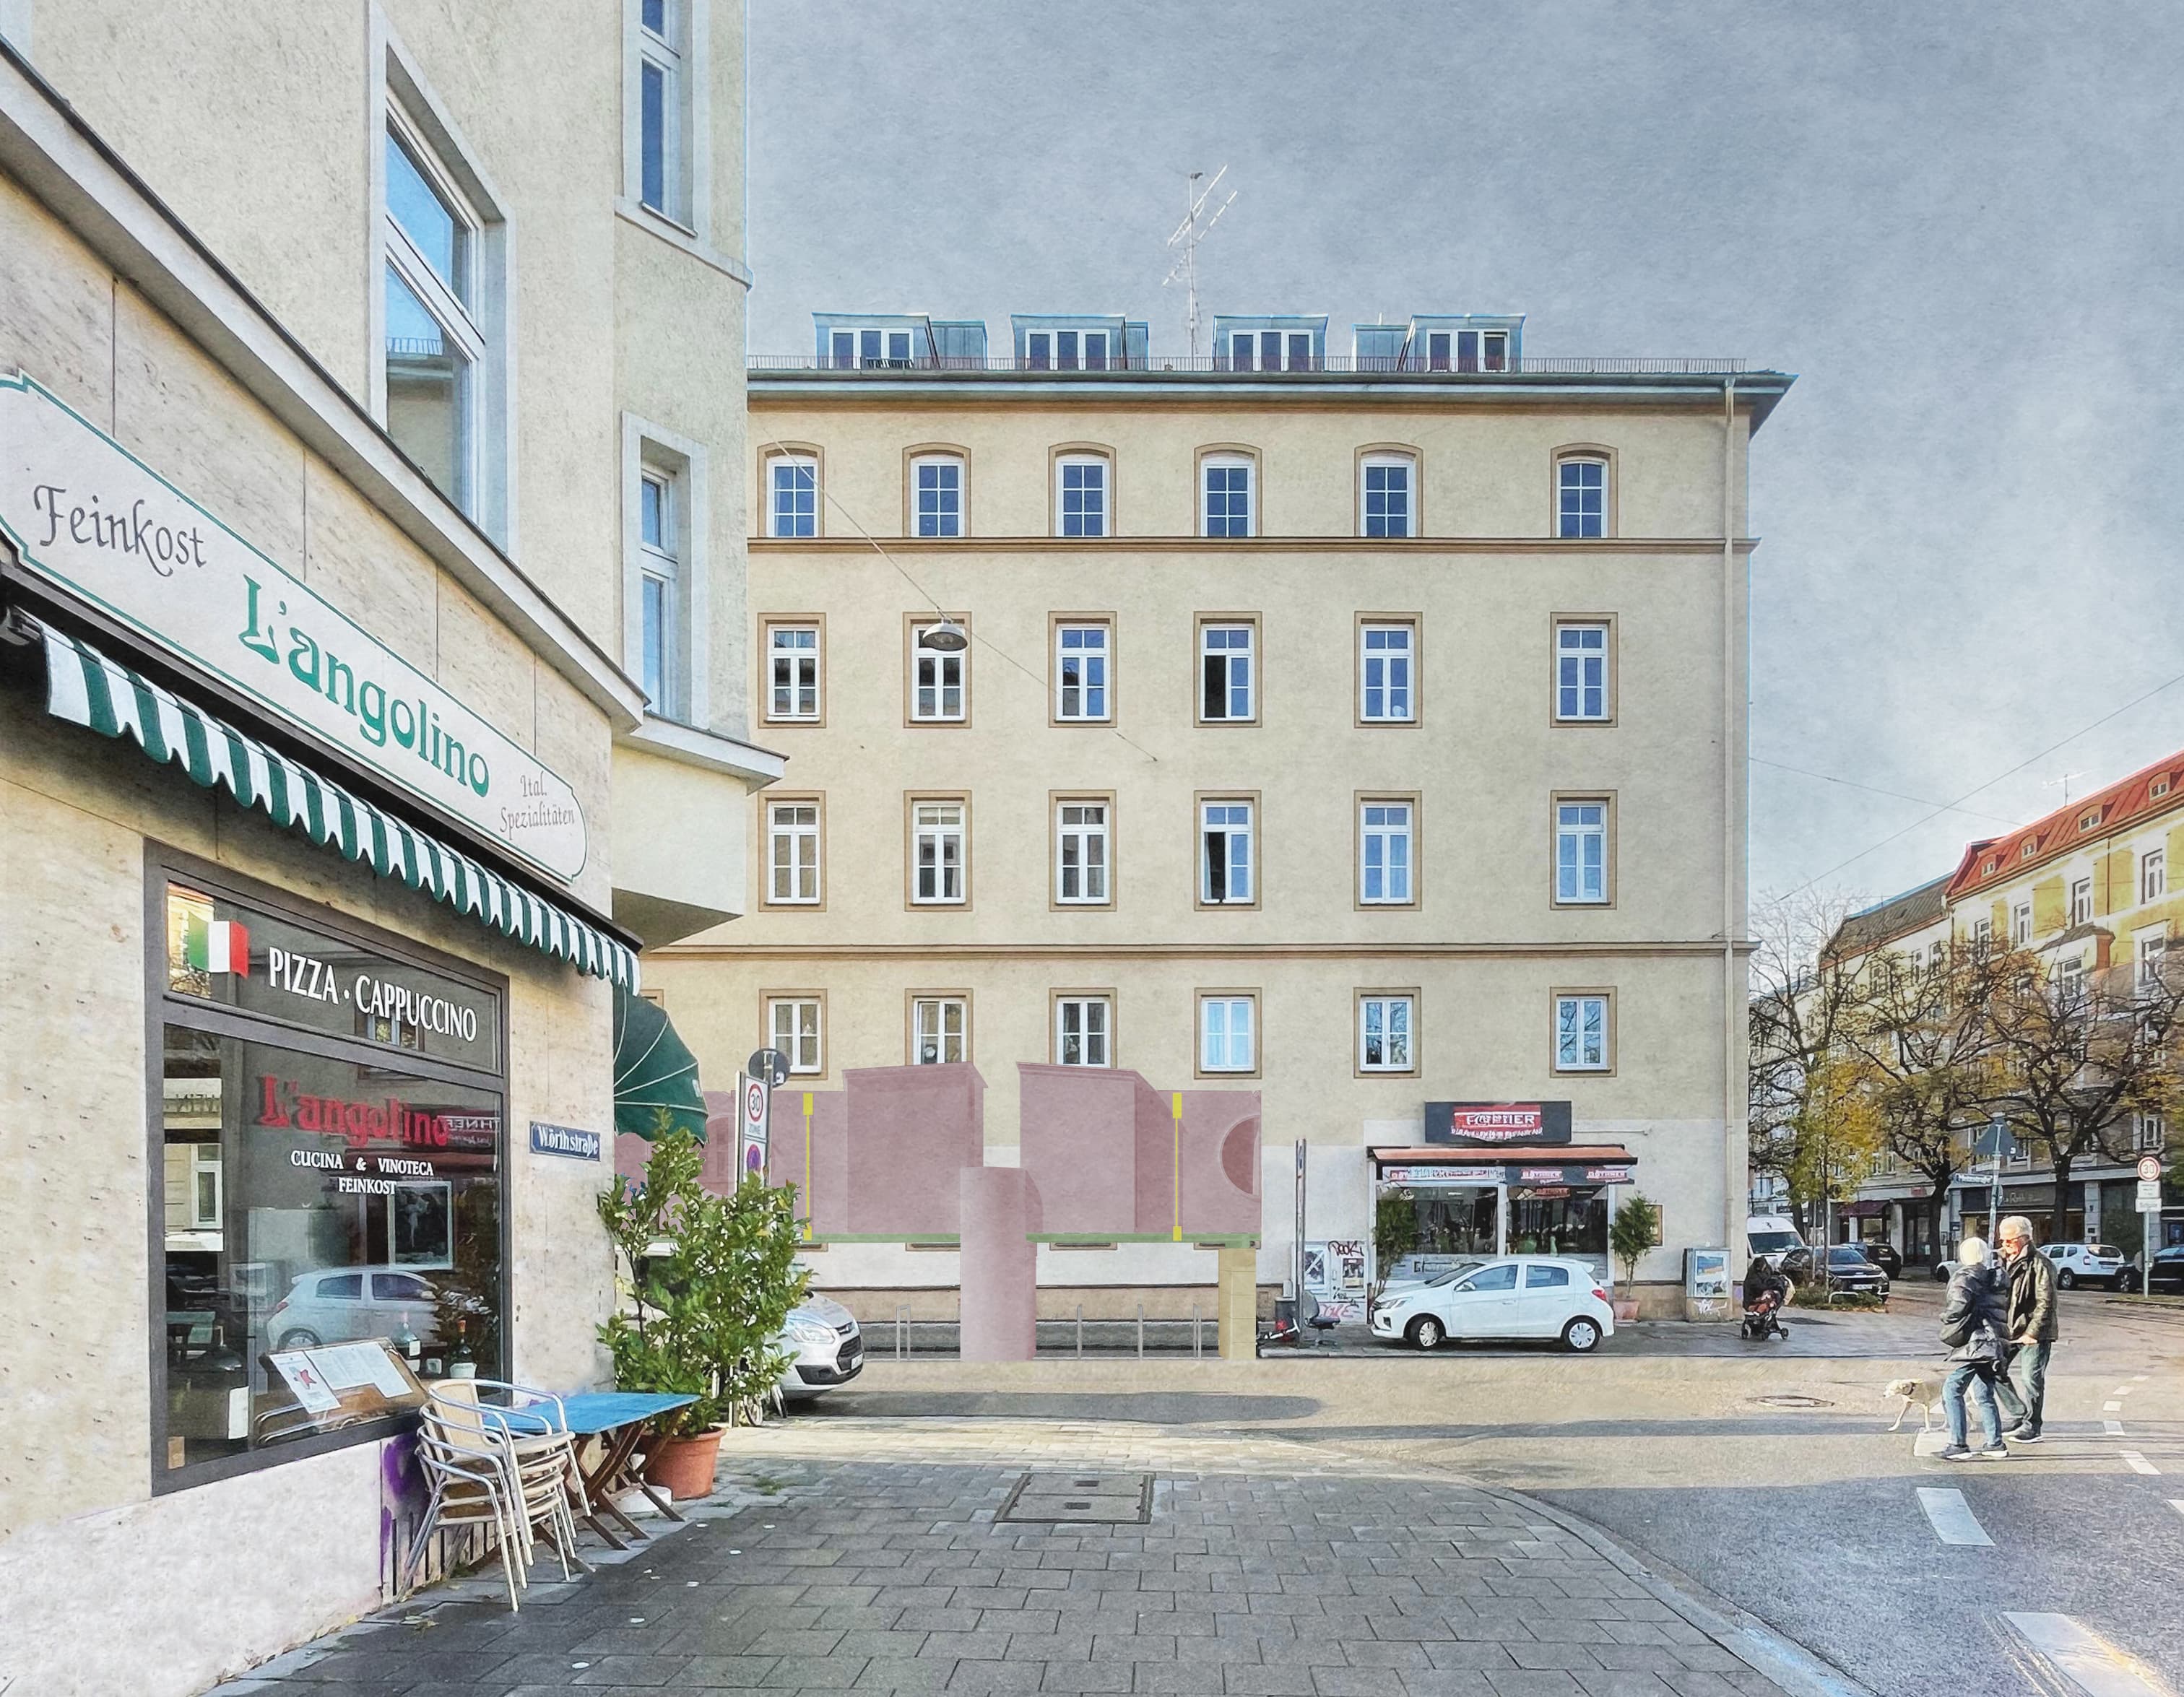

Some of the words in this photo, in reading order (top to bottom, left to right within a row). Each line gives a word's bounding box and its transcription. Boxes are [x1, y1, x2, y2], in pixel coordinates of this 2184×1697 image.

[34, 485, 207, 577] Feinkost
[238, 574, 490, 797] L'angolino
[520, 771, 547, 797] Ital.
[500, 801, 574, 841] Spezialitäten
[269, 947, 339, 1004] PIZZA
[355, 975, 477, 1042] CAPPUCCINO
[260, 1075, 450, 1147] L'angolino
[751, 1093, 760, 1111] 30
[537, 1125, 599, 1157] Wörthstraße
[290, 1150, 344, 1170] CUCINA
[356, 1157, 367, 1171] &
[378, 1158, 433, 1176] VINOTECA
[2143, 1164, 2154, 1174] 30
[339, 1177, 396, 1195] FEINKOST
